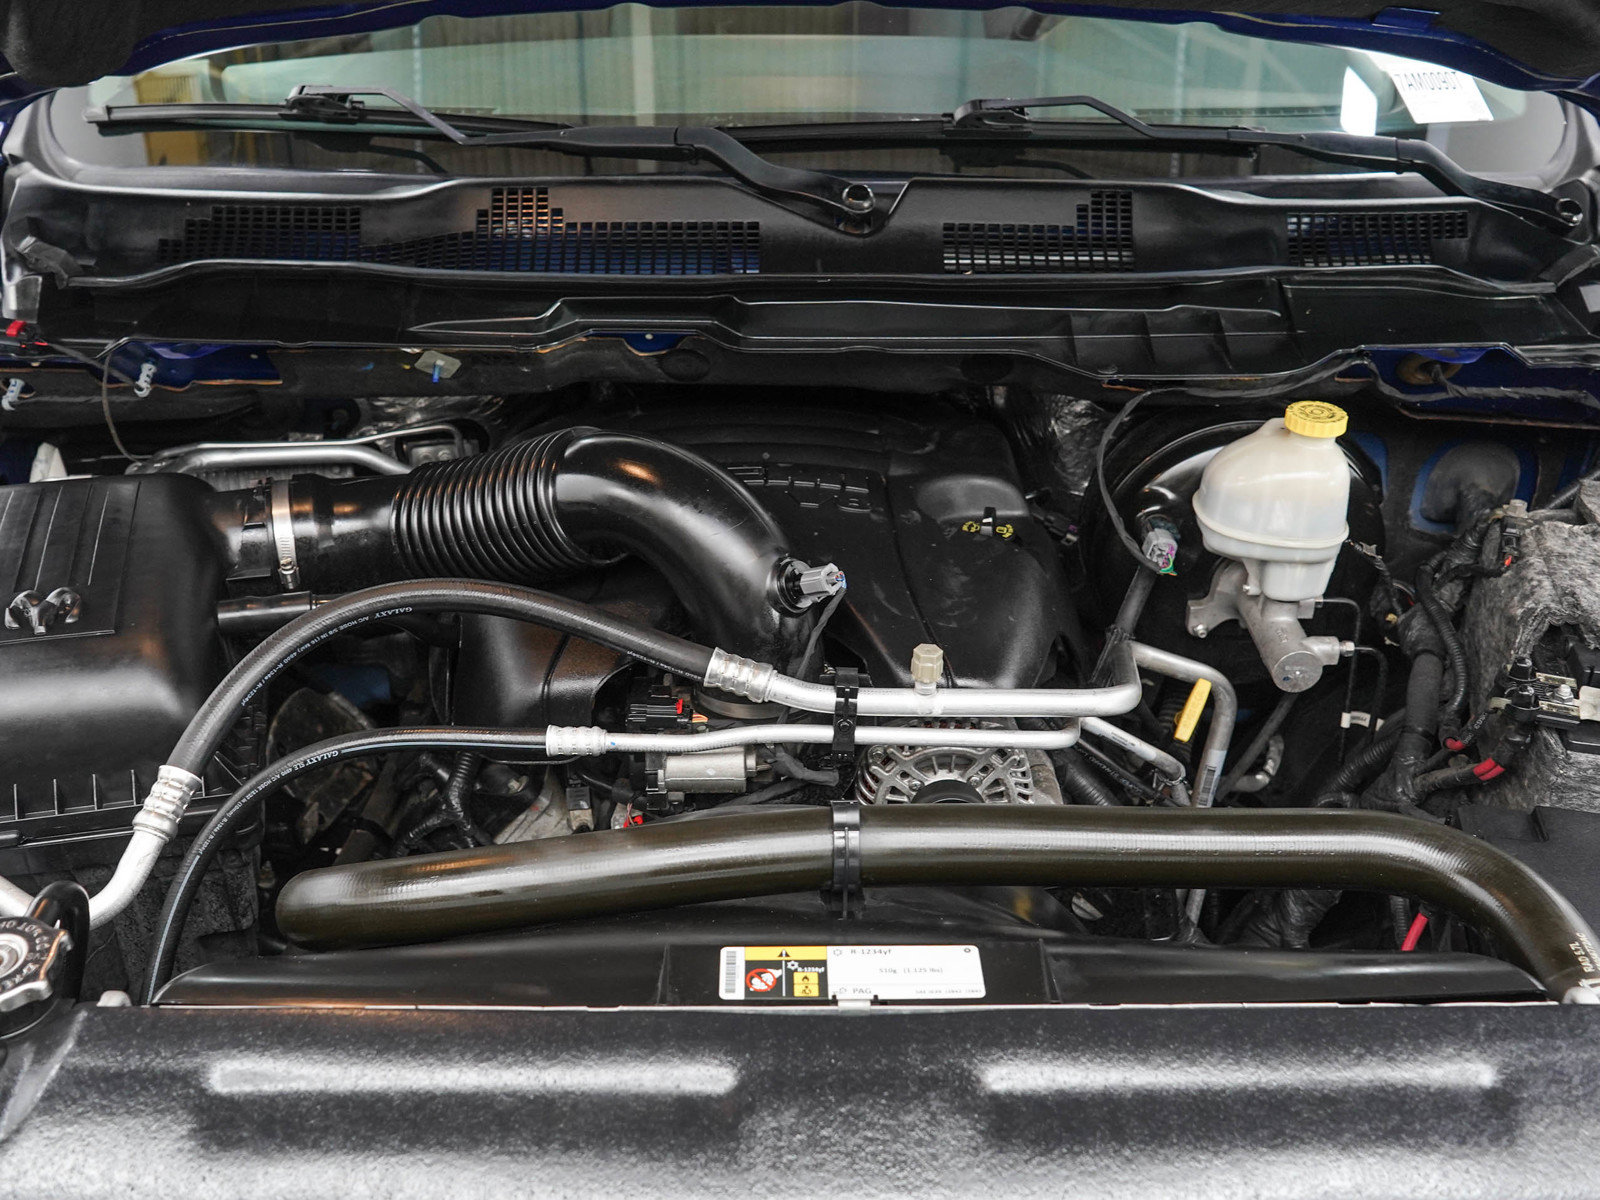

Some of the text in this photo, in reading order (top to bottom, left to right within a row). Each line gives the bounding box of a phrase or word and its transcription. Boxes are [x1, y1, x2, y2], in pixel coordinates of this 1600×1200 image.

[375, 606, 412, 619] GALAXY
[340, 621, 358, 630] HOSE
[306, 750, 339, 766] GALAXY
[293, 762, 305, 771] SLE
[258, 780, 272, 791] HOSE
